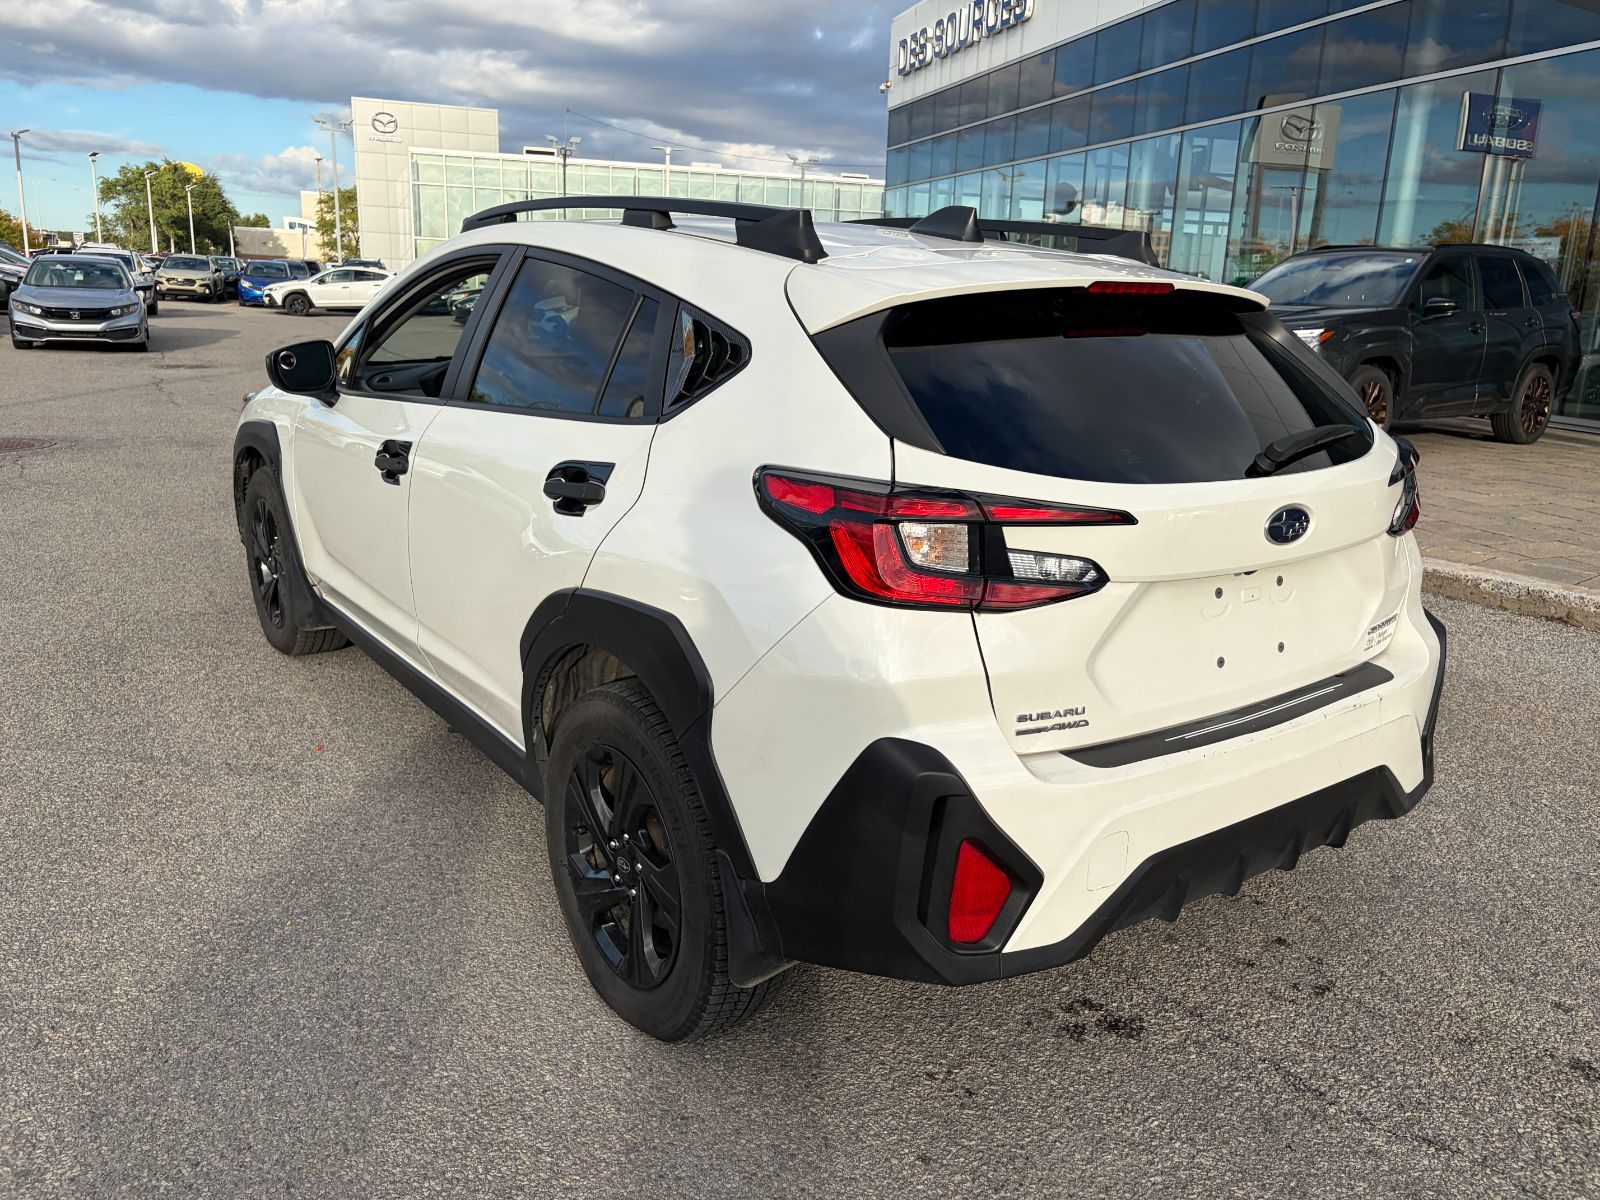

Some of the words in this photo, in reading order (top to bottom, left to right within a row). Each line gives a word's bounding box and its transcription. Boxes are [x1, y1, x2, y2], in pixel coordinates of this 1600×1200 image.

[898, 26, 933, 76] DES
[933, 0, 1034, 59] SOURCES
[1016, 705, 1086, 723] SUBARU
[1046, 719, 1090, 733] AWD
